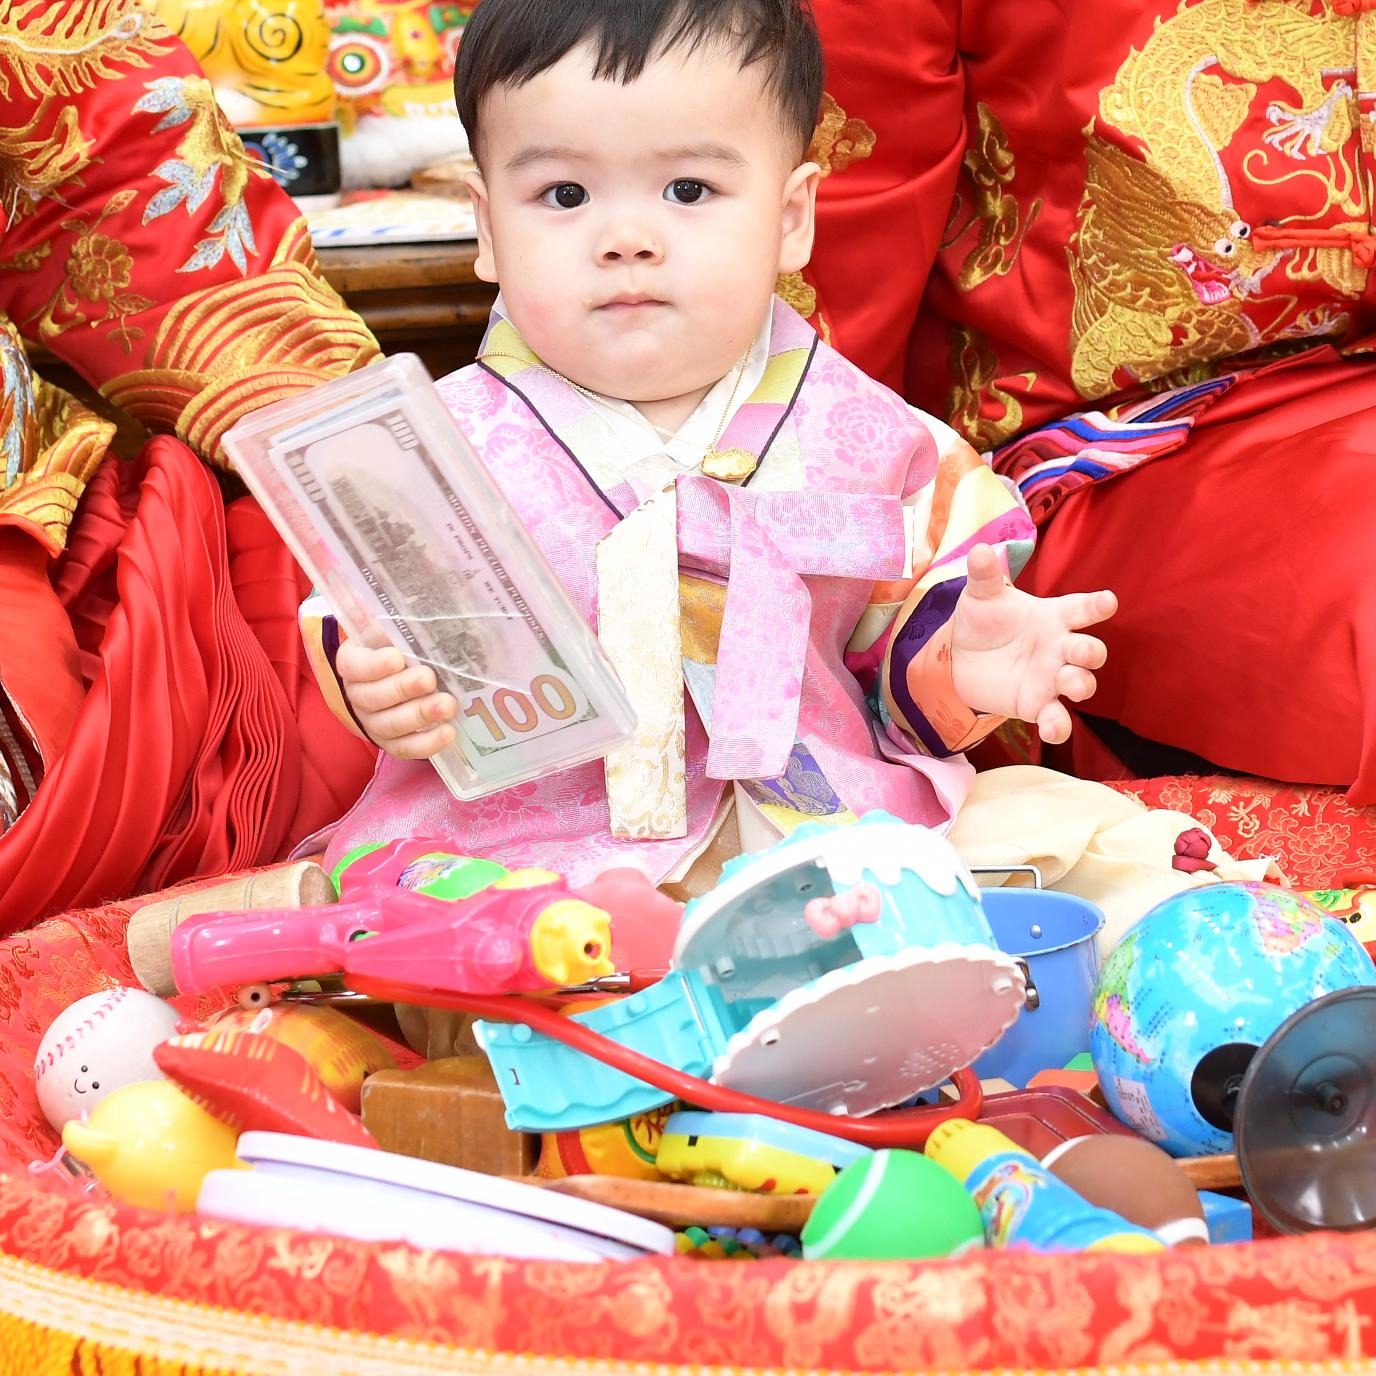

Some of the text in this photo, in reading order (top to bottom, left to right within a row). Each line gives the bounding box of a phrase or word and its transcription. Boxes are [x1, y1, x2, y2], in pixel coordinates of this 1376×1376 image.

[362, 567, 379, 590] ONE
[447, 494, 545, 640] MOTION PICTURE PURPOSES
[464, 674, 577, 742] 100
